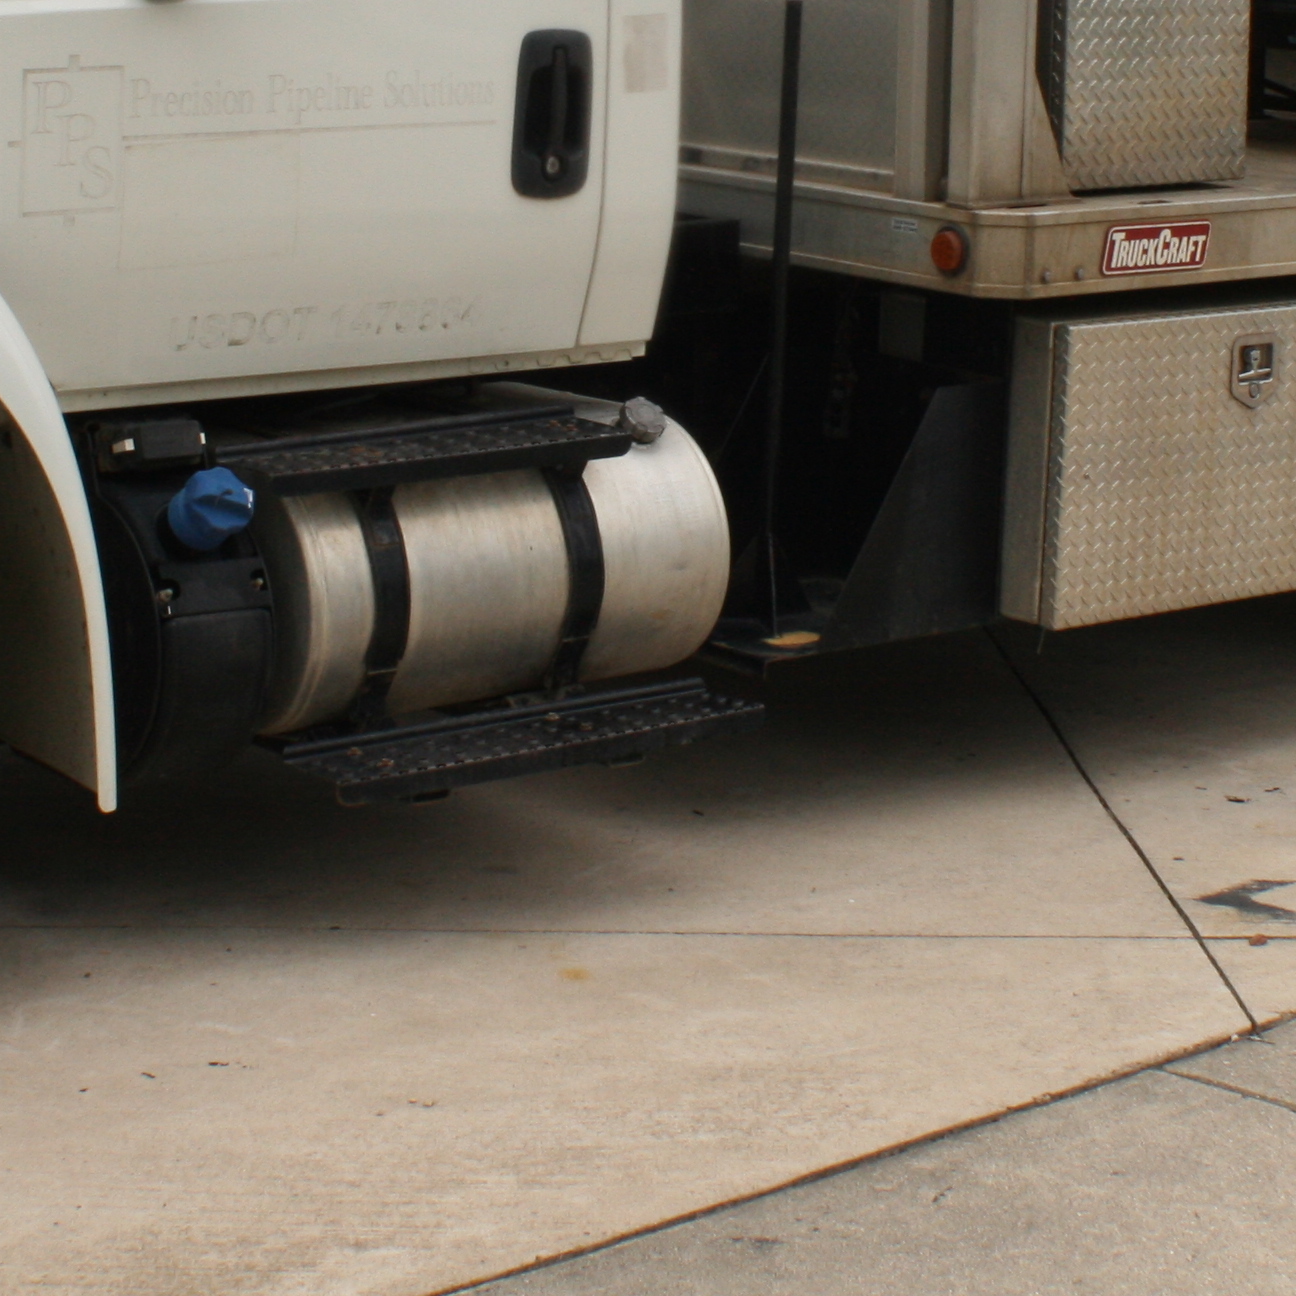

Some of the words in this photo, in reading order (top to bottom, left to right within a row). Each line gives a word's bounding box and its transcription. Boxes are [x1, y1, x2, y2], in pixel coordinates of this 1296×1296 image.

[129, 78, 253, 119] Precision
[265, 72, 374, 125] Pipeline
[383, 69, 495, 108] Solutions
[170, 306, 318, 352] USDOT
